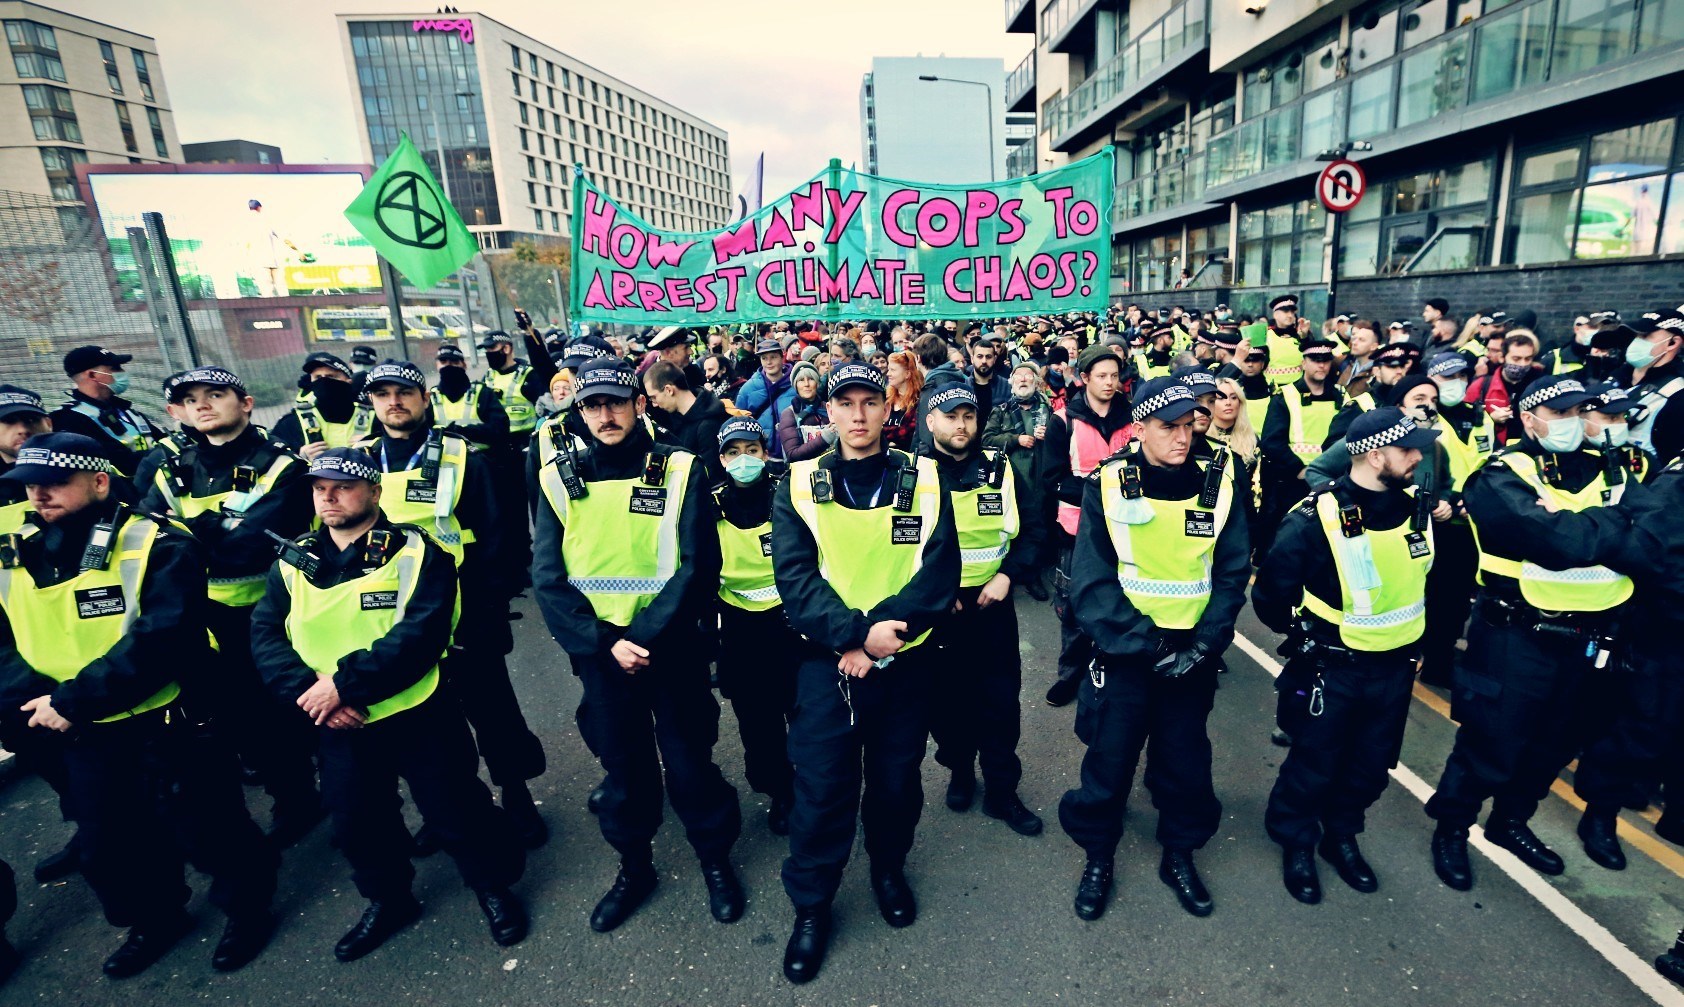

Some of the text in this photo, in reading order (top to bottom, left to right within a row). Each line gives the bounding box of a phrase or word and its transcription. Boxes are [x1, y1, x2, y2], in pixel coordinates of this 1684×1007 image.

[582, 180, 1099, 270] HOW MANY COPS TO
[582, 267, 748, 313] ARREST
[943, 250, 1099, 304] CHAOS?
[100, 606, 124, 614] OFFICER
